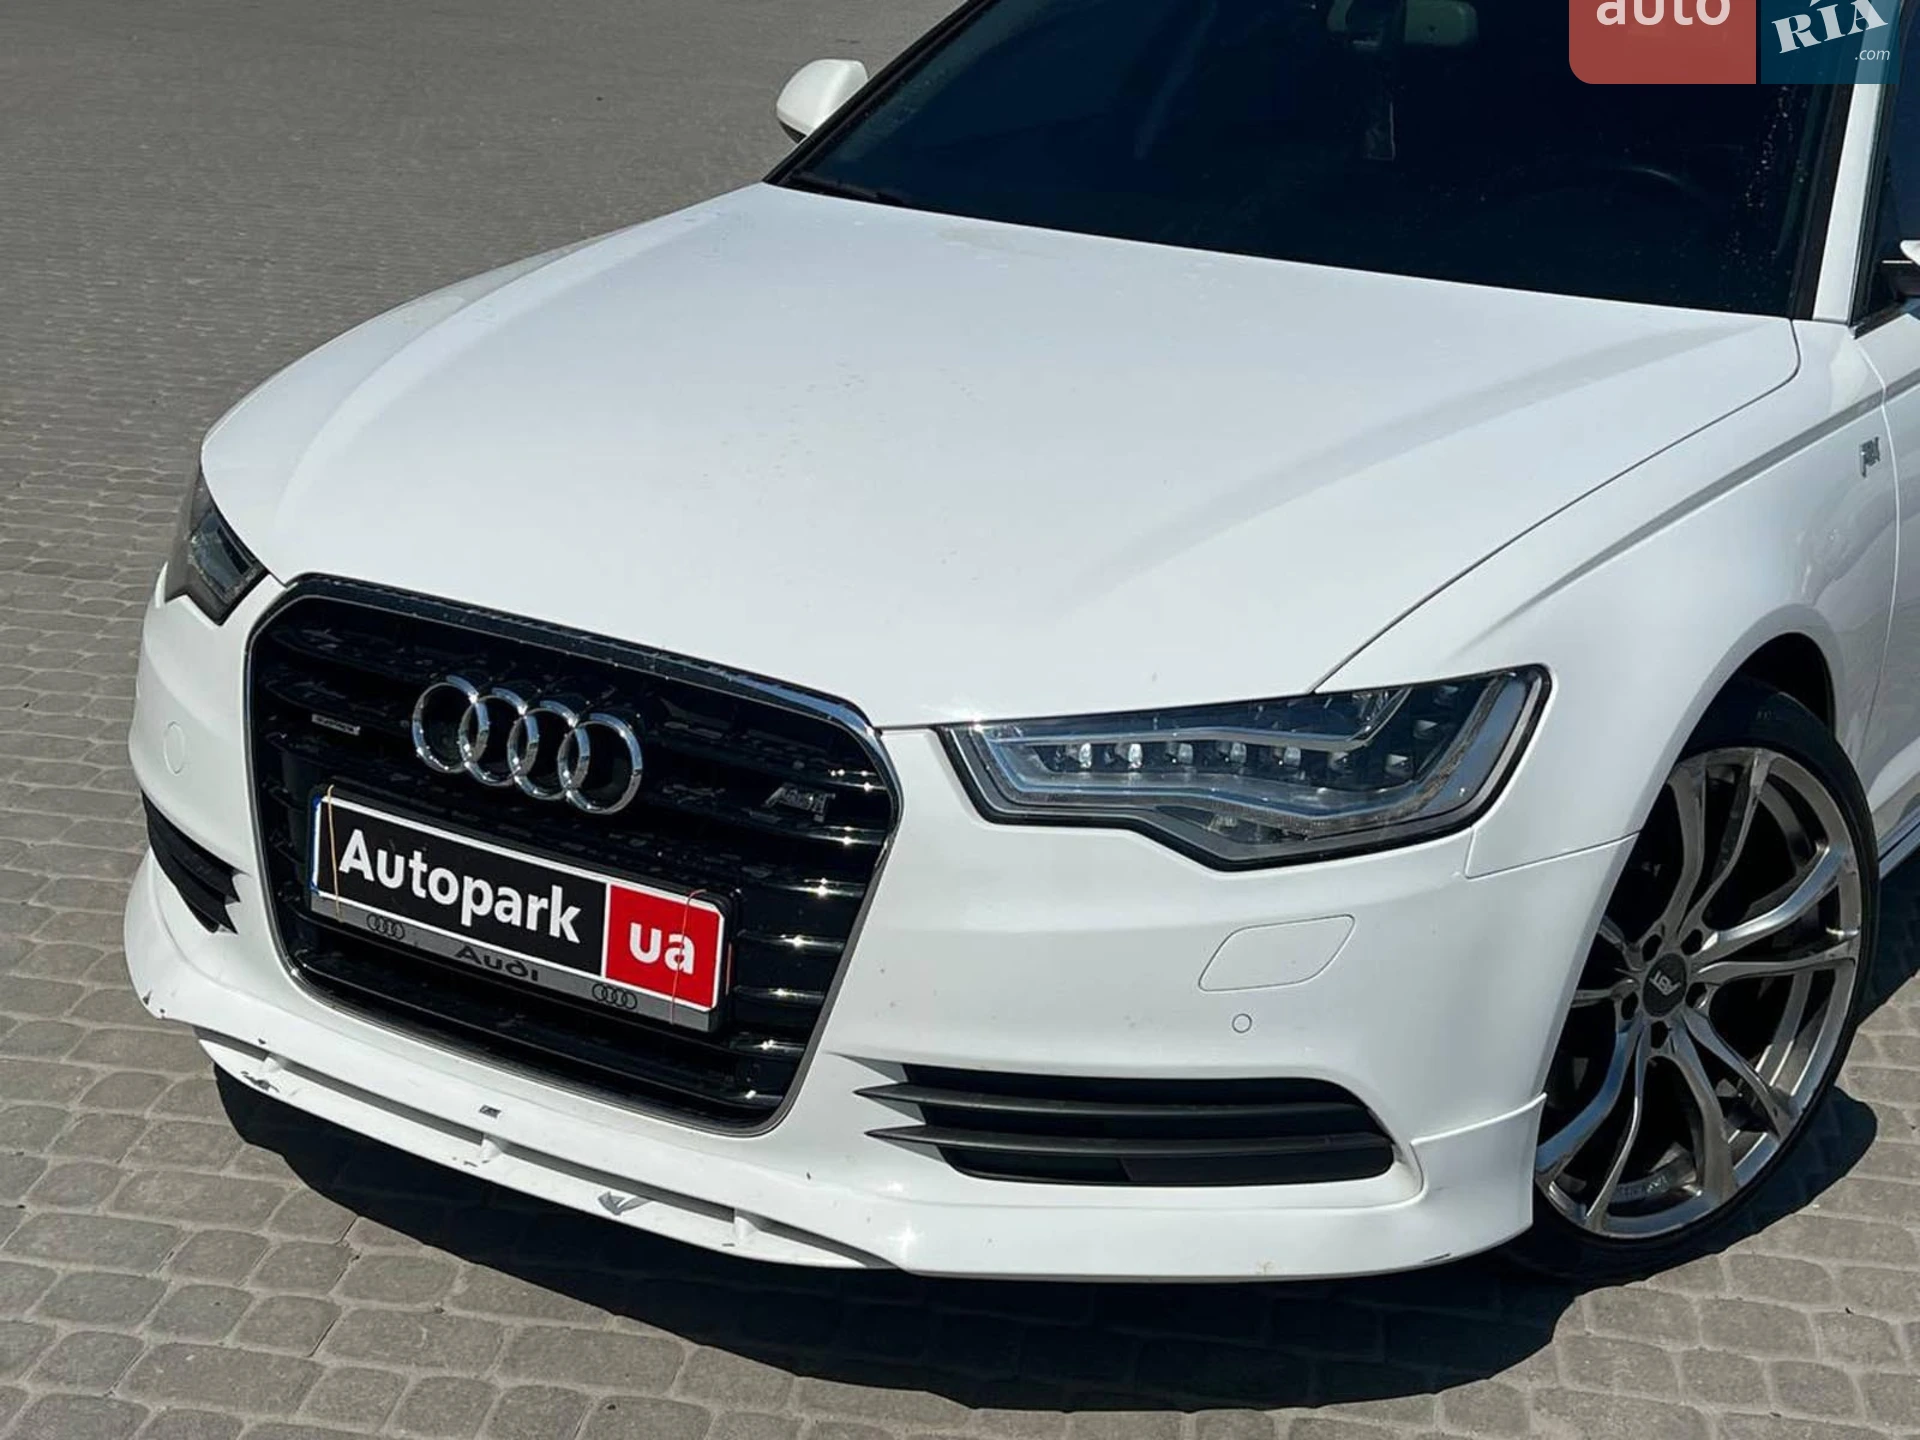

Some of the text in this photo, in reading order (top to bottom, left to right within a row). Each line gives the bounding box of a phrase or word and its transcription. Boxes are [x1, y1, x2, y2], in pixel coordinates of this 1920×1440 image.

[338, 829, 695, 975] Autopark ua
[454, 945, 539, 982] Audi
